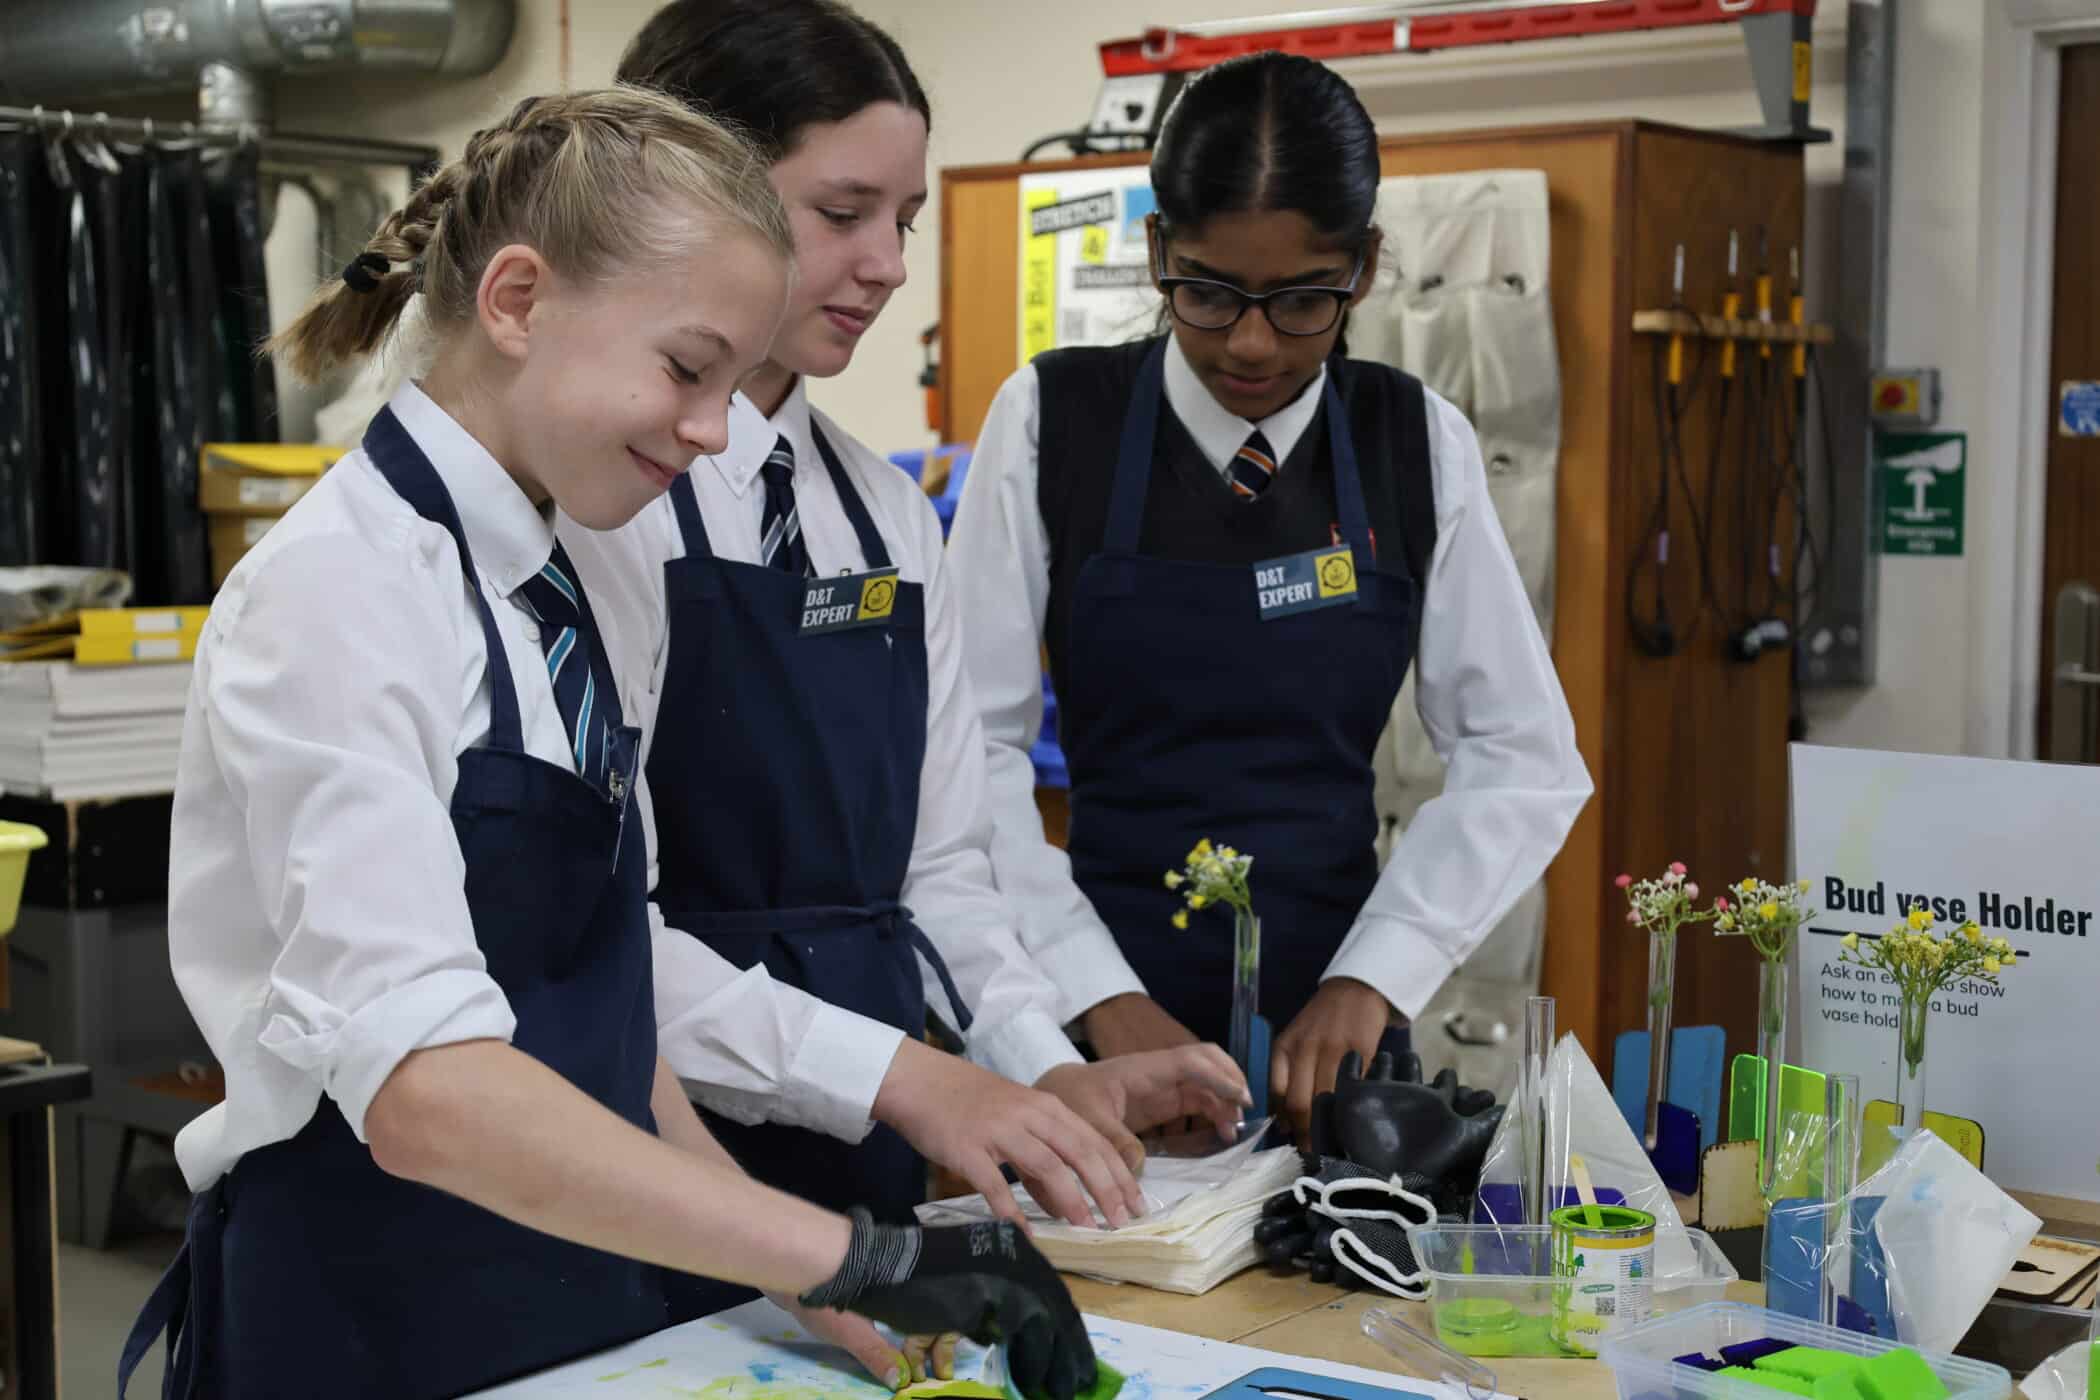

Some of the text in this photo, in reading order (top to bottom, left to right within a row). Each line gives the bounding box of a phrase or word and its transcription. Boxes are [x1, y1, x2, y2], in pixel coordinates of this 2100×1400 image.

[1256, 566, 1286, 589] D&T
[805, 586, 835, 607] D&T
[1259, 581, 1313, 609] EXPERT
[801, 603, 855, 628] EXPERT
[1825, 875, 1885, 915] Bud
[1979, 892, 2093, 937] Holder
[1821, 962, 1851, 981] Ask
[1855, 969, 1880, 984] an
[1960, 980, 2006, 999] show
[1821, 984, 1856, 1003] how
[1861, 990, 1878, 1006] to
[1931, 1001, 1942, 1014] a
[1947, 999, 1979, 1018] bud
[1822, 1008, 1860, 1025] vase
